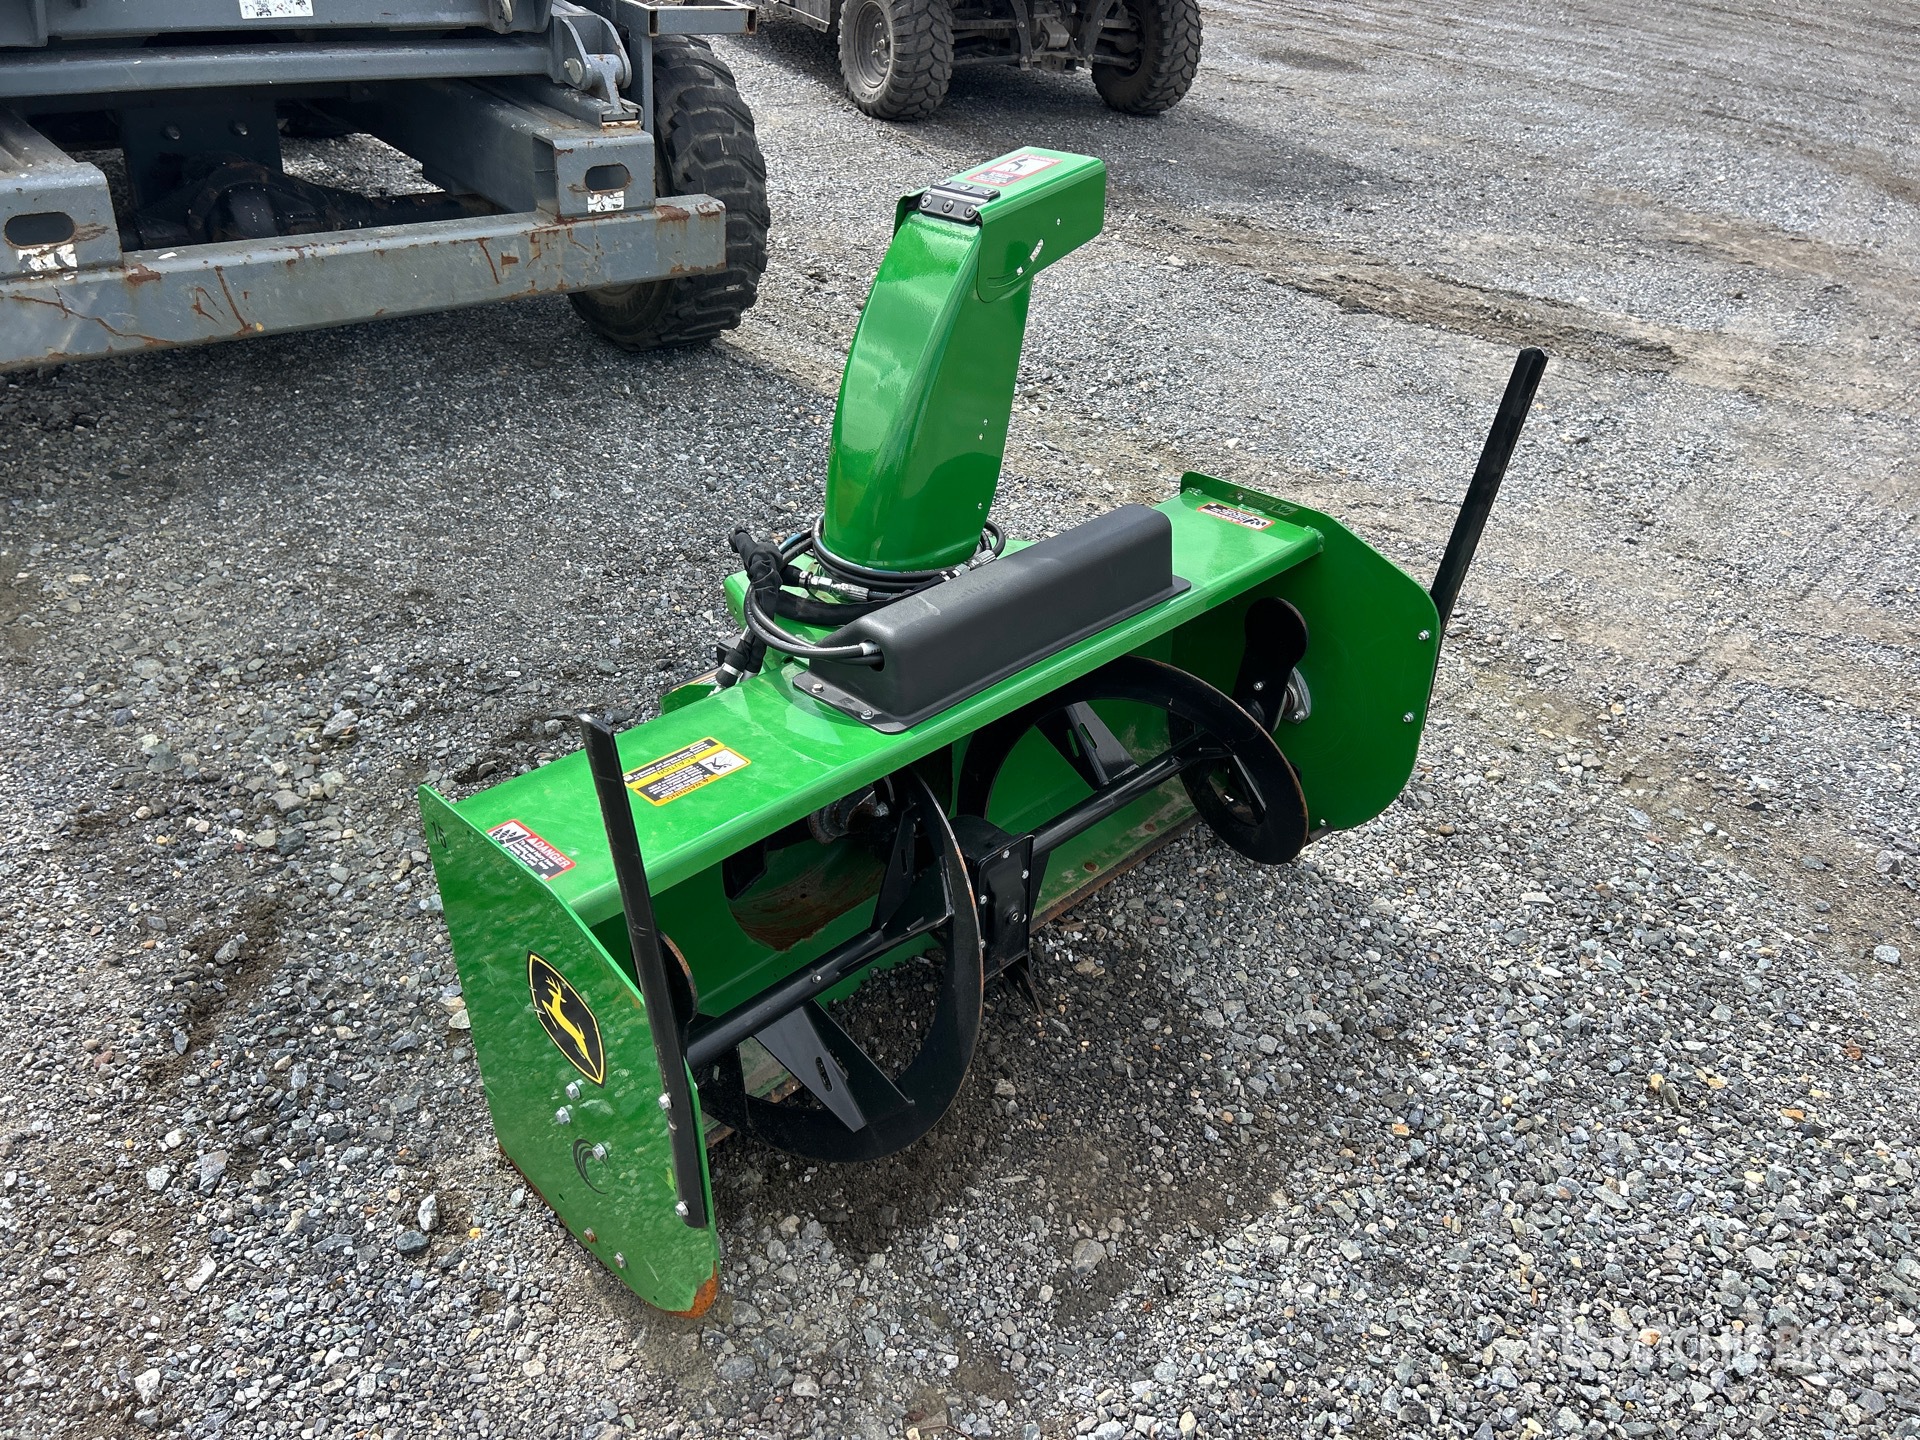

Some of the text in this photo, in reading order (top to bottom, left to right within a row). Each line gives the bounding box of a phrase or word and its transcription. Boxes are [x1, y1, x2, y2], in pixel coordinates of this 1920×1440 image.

[657, 759, 691, 776] CAUTION
[666, 782, 703, 801] WARNING
[535, 840, 571, 868] DANGER
